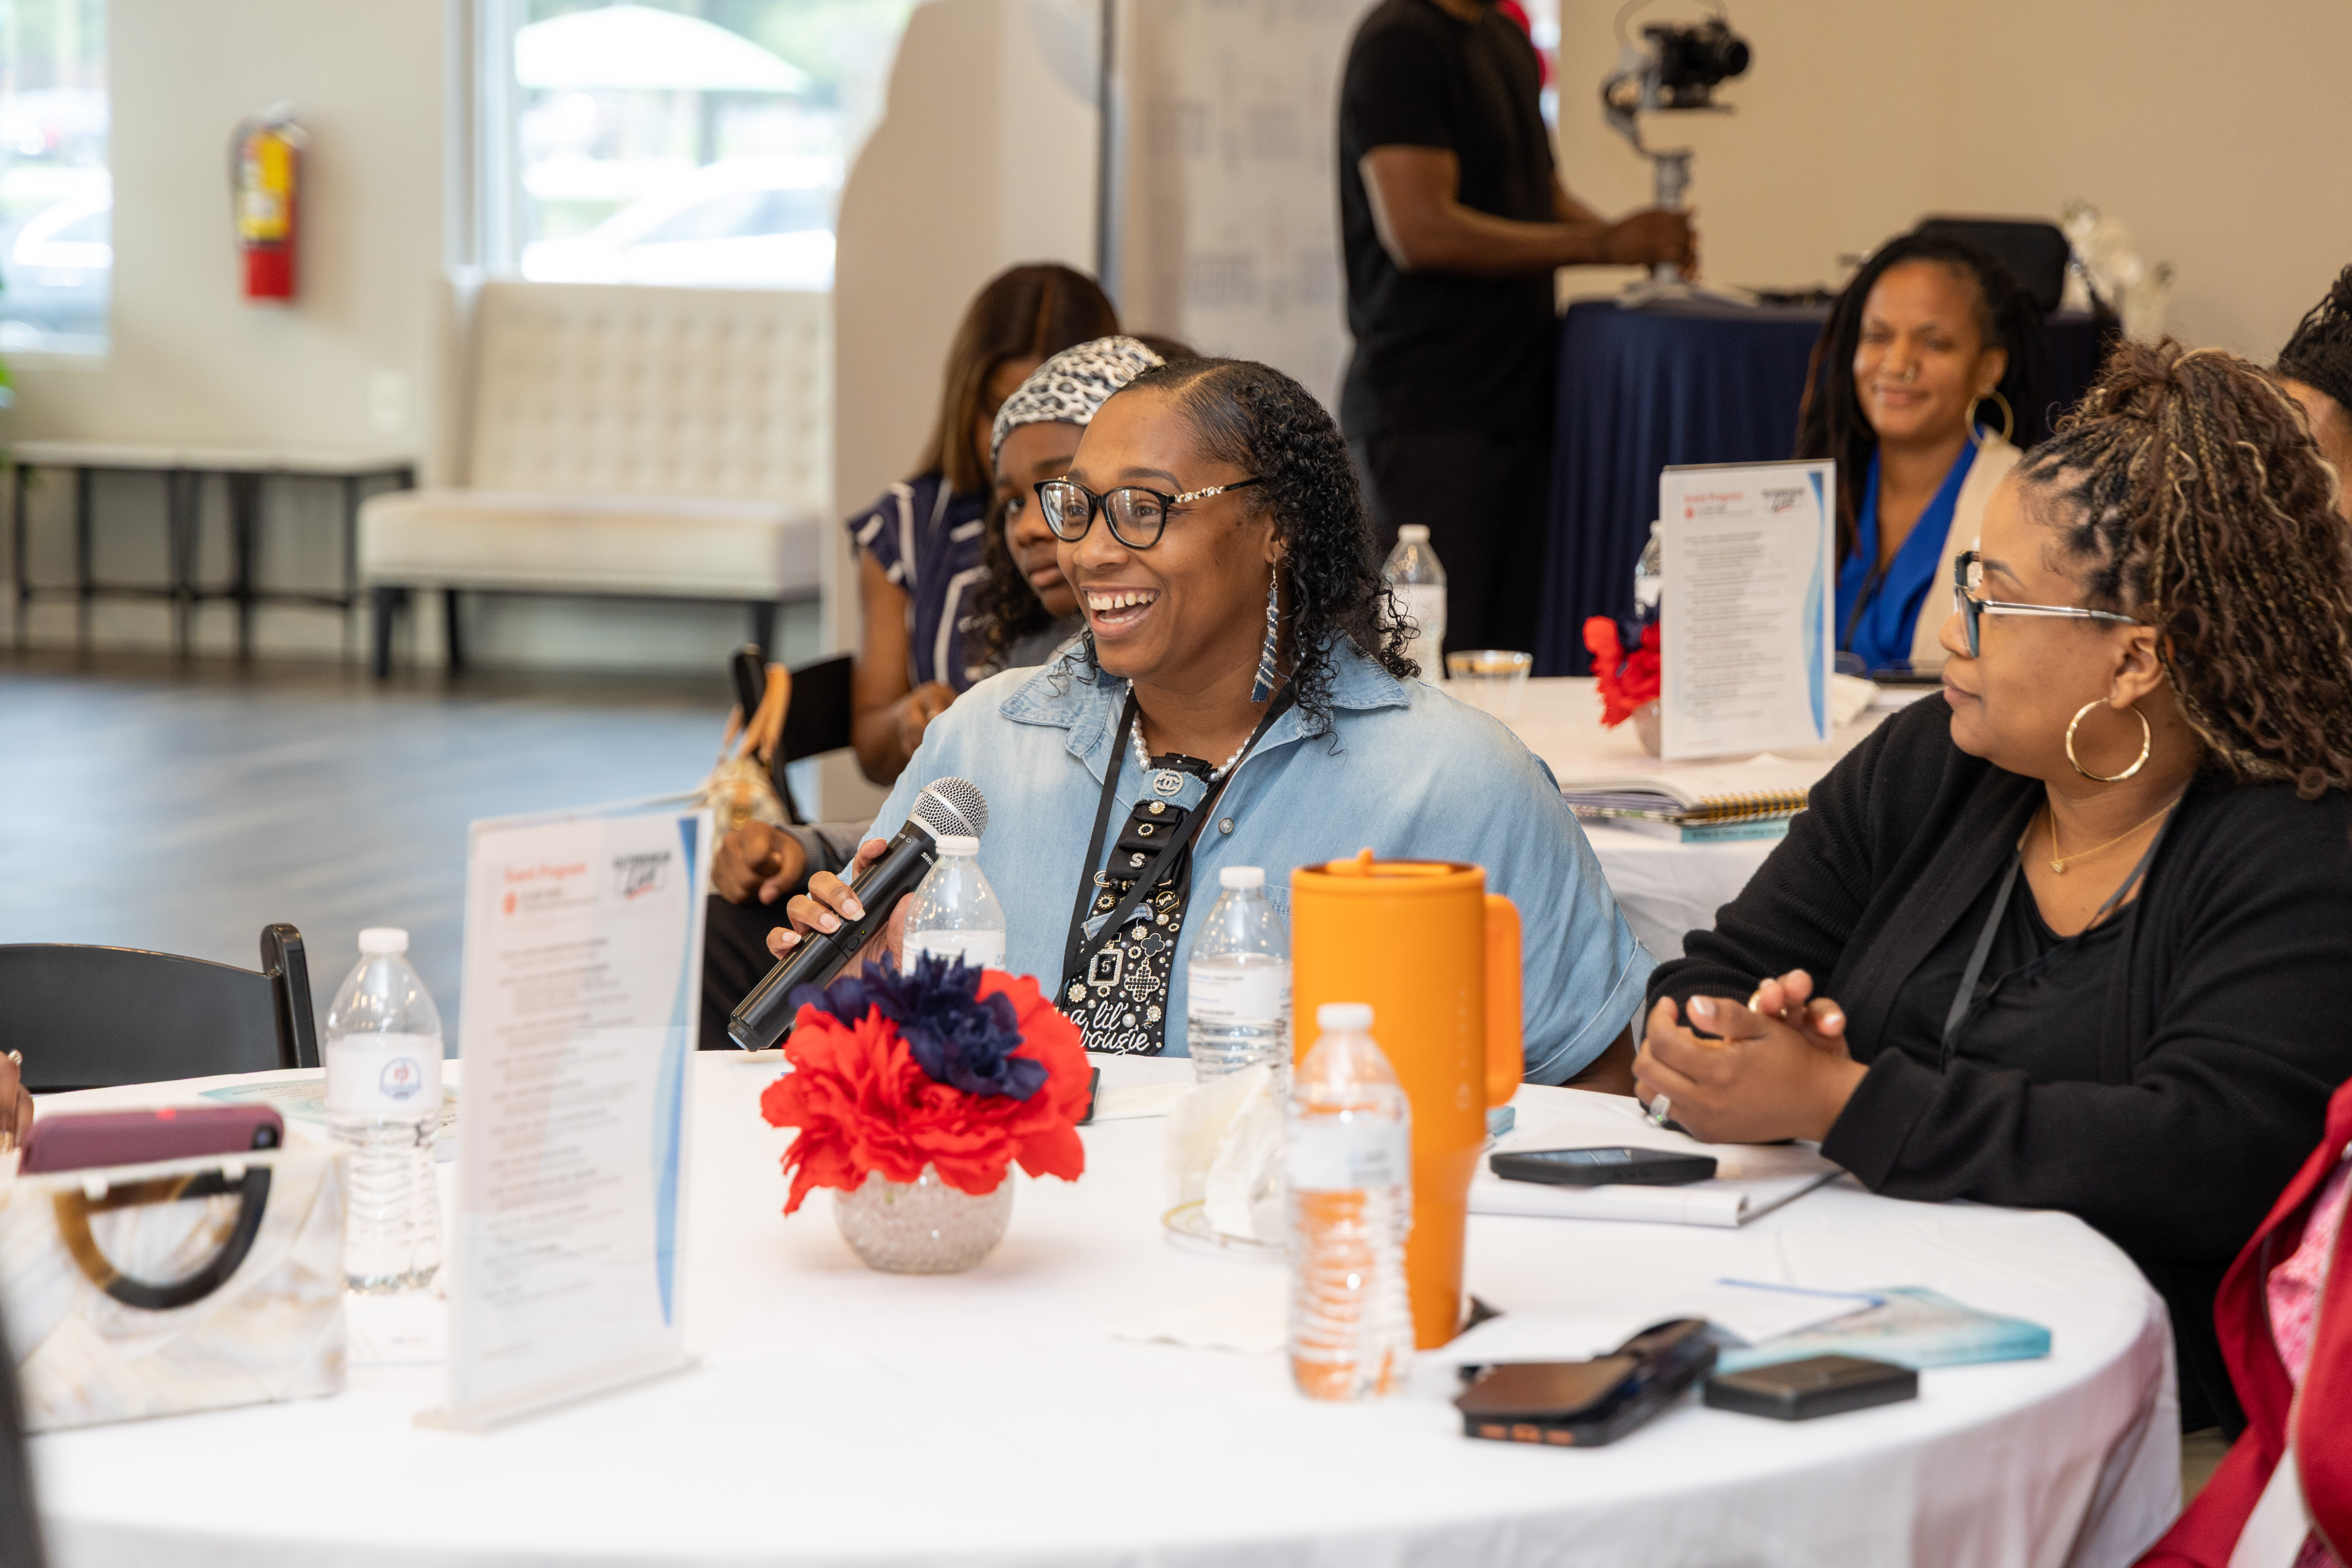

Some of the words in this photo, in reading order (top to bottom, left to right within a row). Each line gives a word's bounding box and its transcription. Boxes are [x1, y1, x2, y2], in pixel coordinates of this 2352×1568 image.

[921, 852, 934, 867] SHU
[1130, 853, 1145, 868] S
[1102, 960, 1110, 972] 5
[1070, 1009, 1087, 1025] a
[1079, 1021, 1150, 1056] bougie
